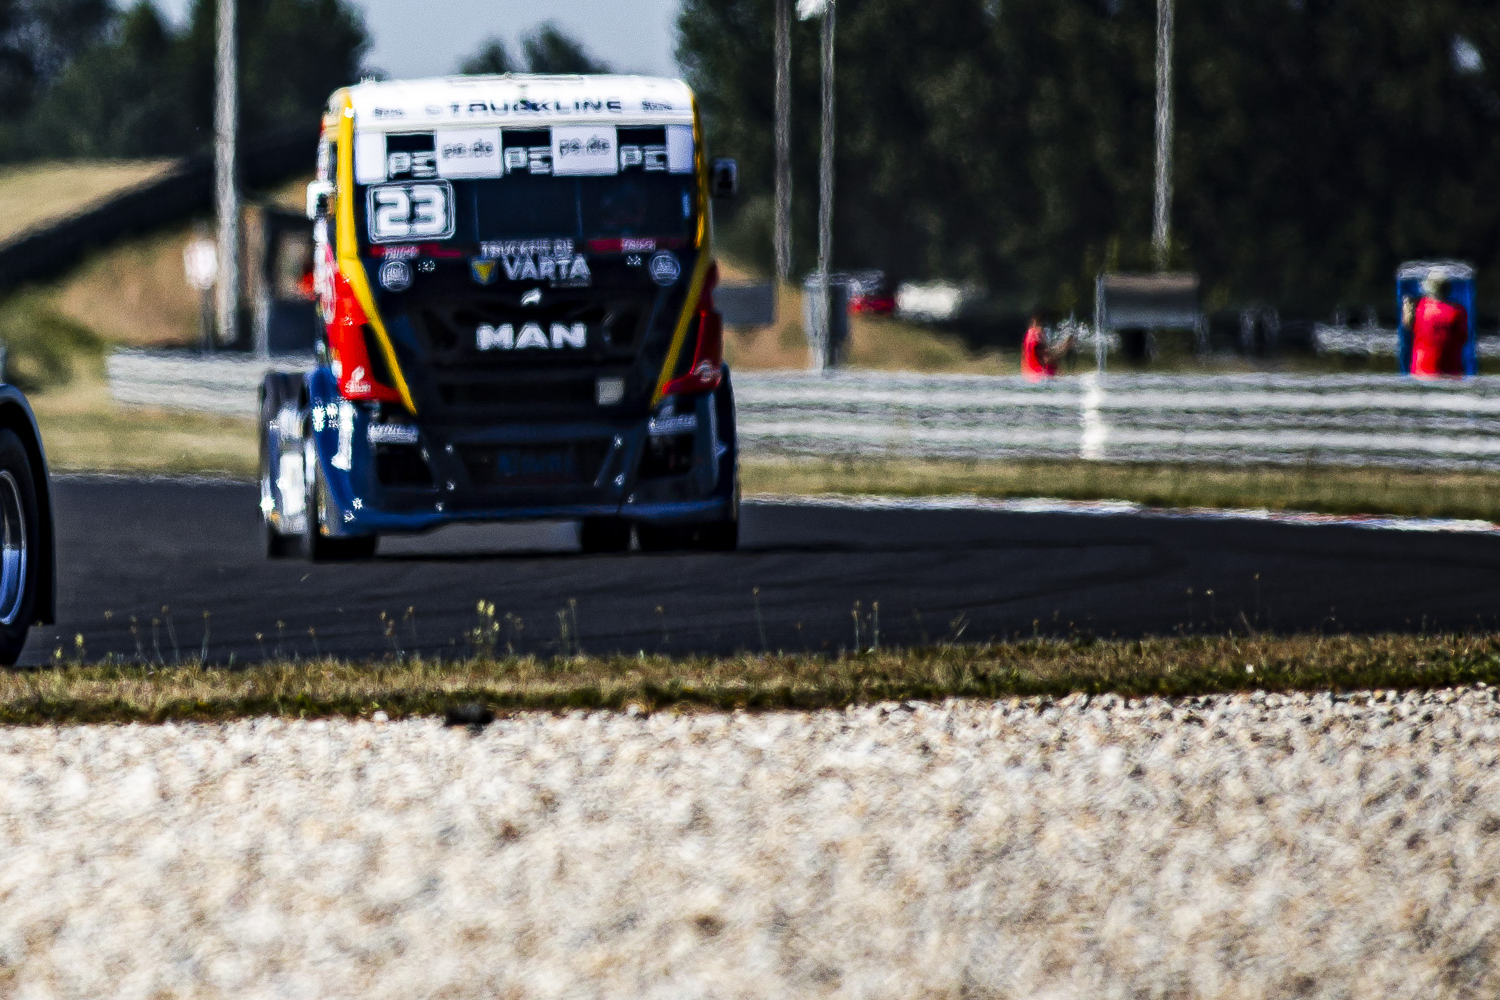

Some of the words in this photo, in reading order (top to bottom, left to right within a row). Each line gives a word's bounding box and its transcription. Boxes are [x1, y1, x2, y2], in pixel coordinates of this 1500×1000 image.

[376, 185, 446, 237] 23
[501, 253, 591, 280] VARTA
[476, 322, 586, 350] MAN
